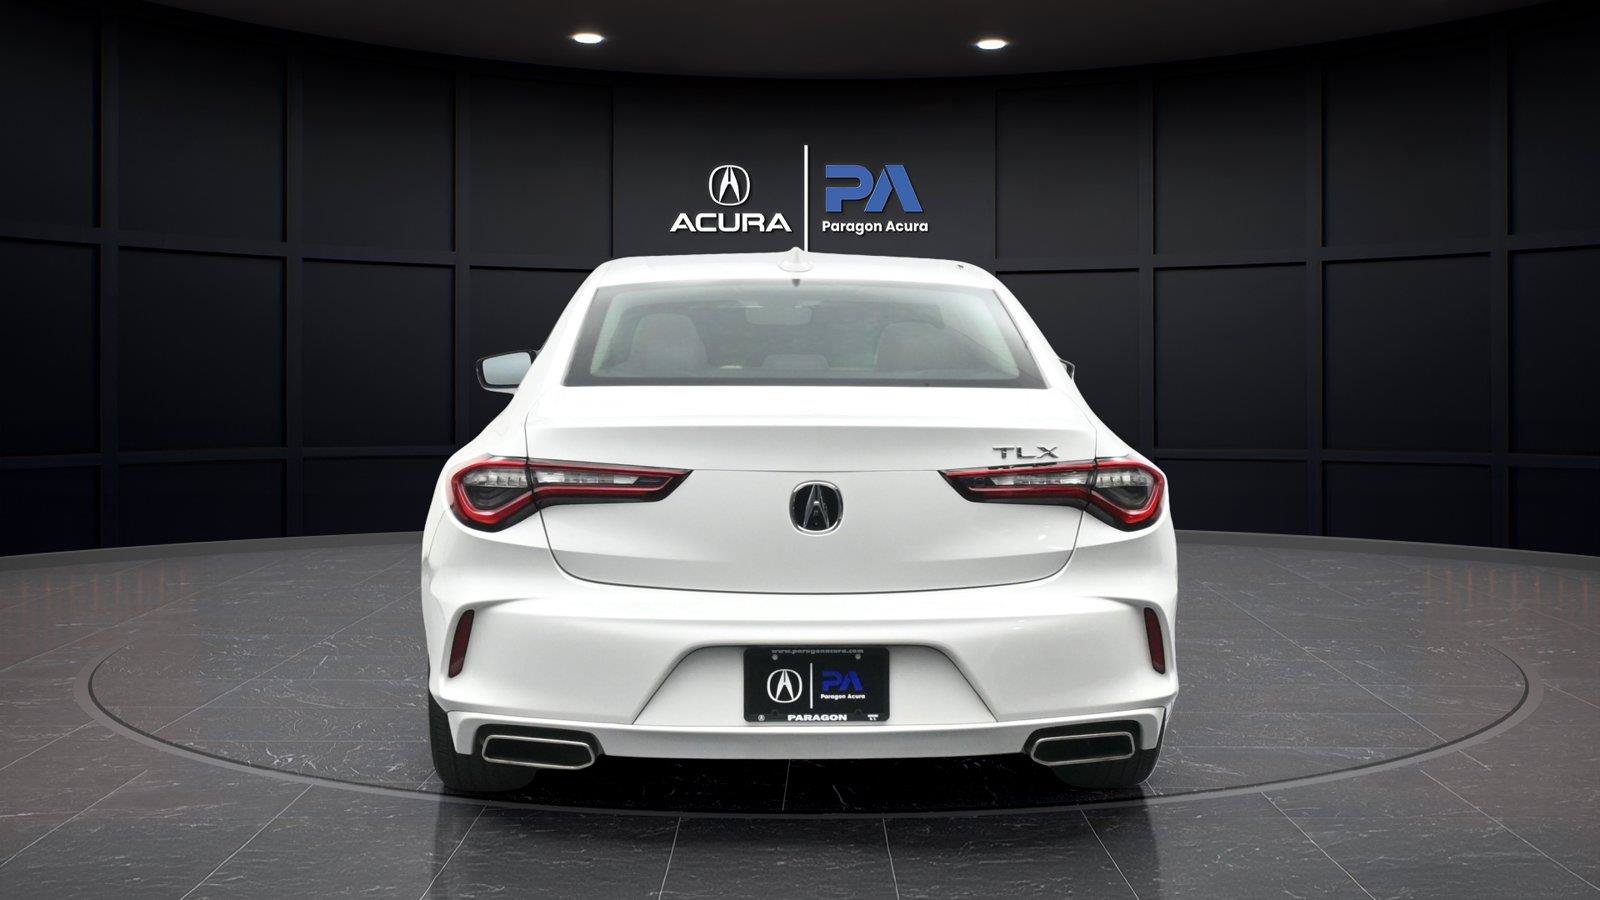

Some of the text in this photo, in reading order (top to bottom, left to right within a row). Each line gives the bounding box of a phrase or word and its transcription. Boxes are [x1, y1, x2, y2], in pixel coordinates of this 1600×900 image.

[825, 164, 924, 213] PA
[669, 212, 793, 233] ACURA
[822, 220, 929, 236] Paragon Acura
[992, 446, 1059, 459] TLX
